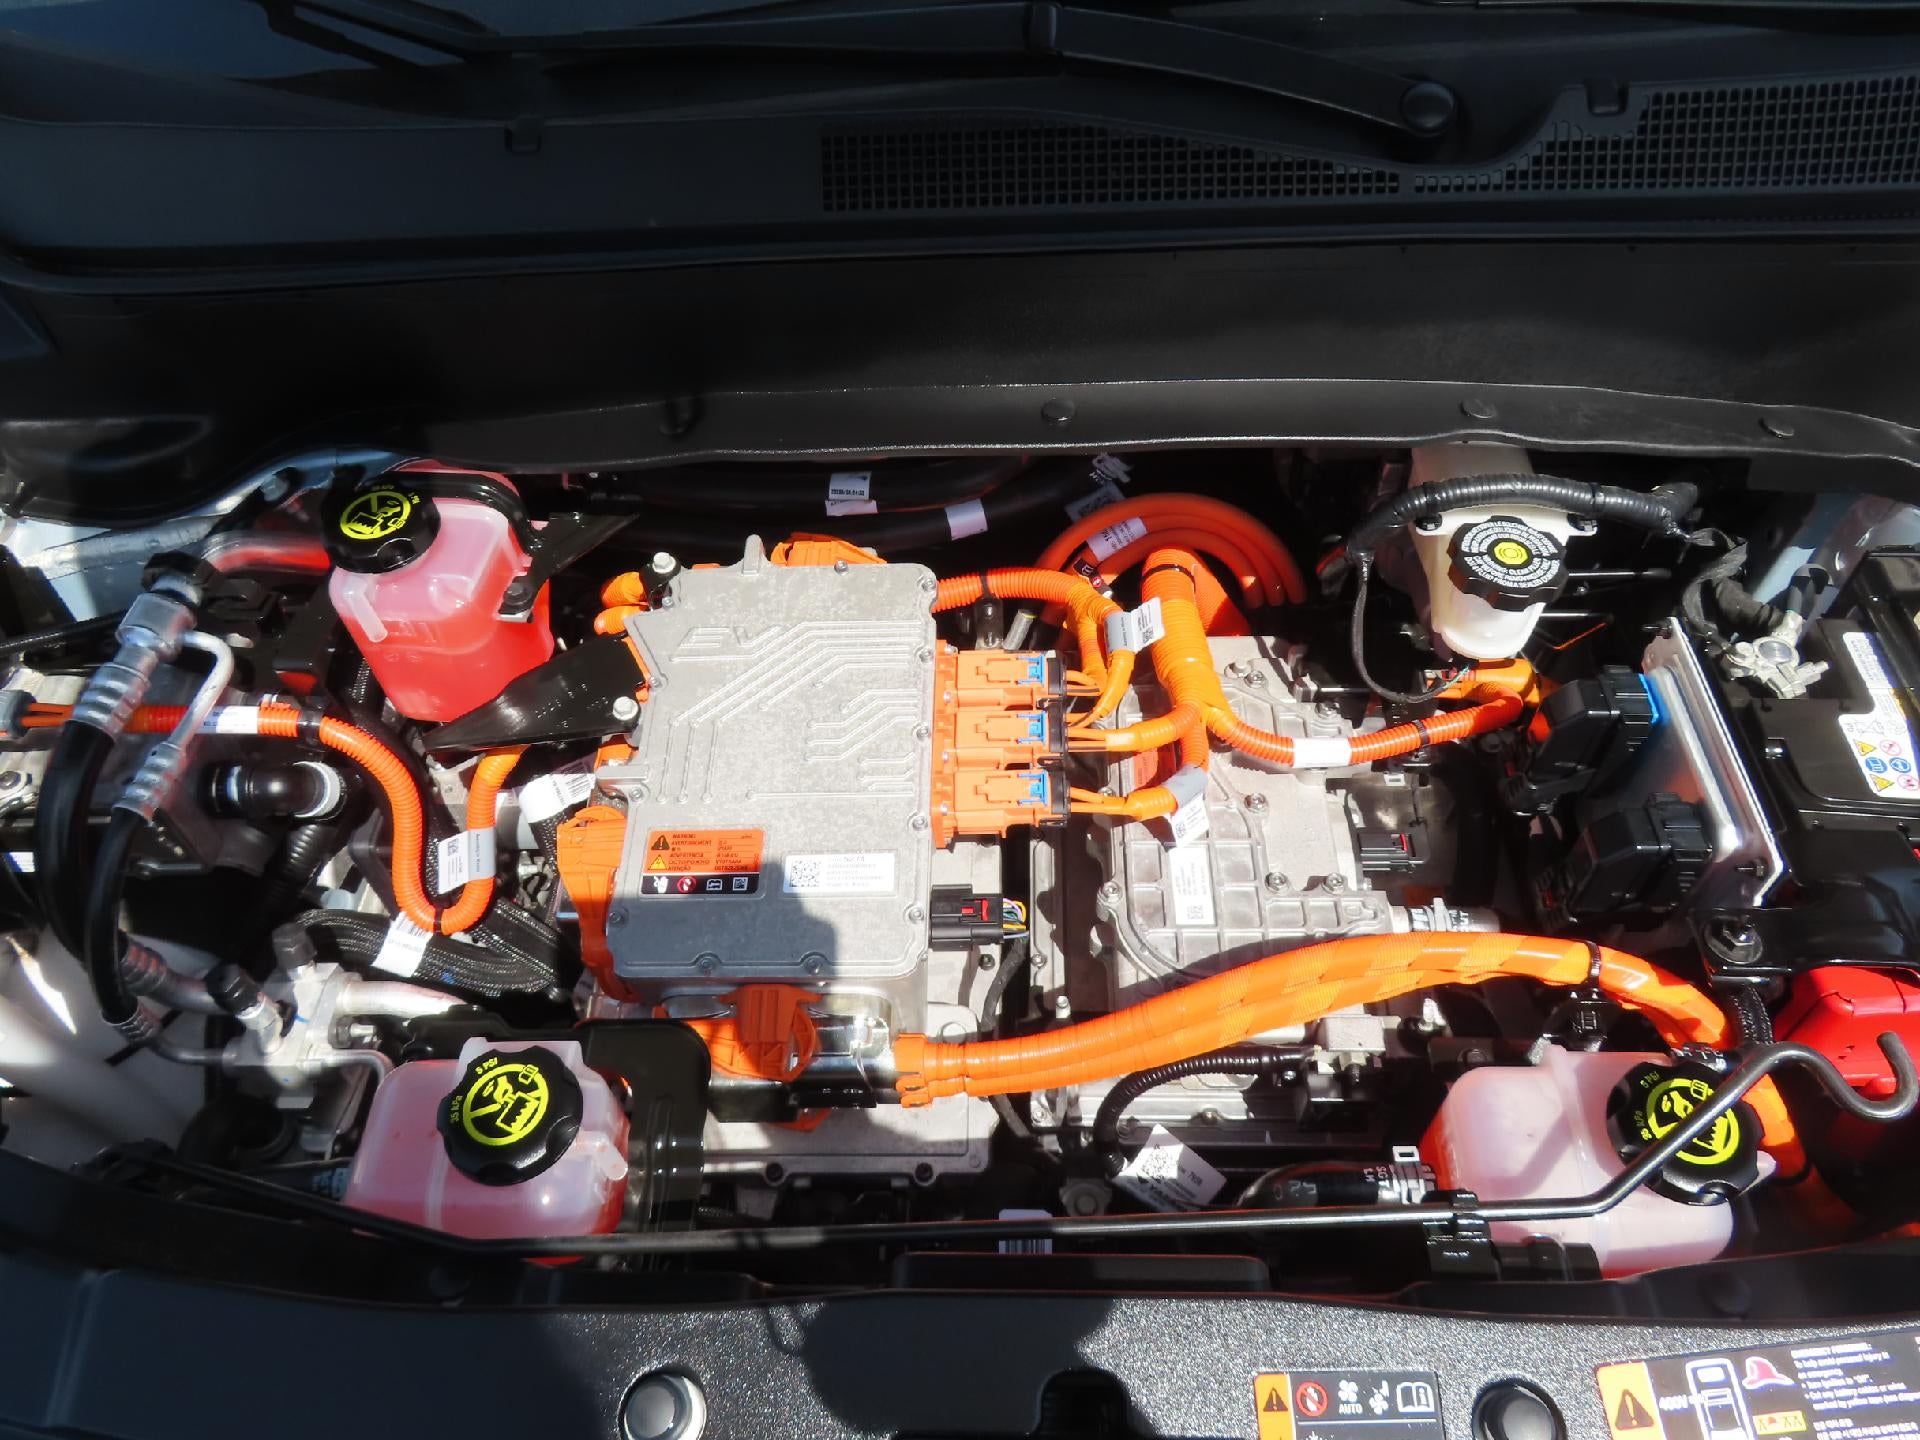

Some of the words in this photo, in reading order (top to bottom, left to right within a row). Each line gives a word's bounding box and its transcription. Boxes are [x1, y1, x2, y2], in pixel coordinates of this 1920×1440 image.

[475, 1066, 483, 1075] 5
[483, 1057, 498, 1070] PSI
[1338, 1403, 1364, 1415] AUTO
